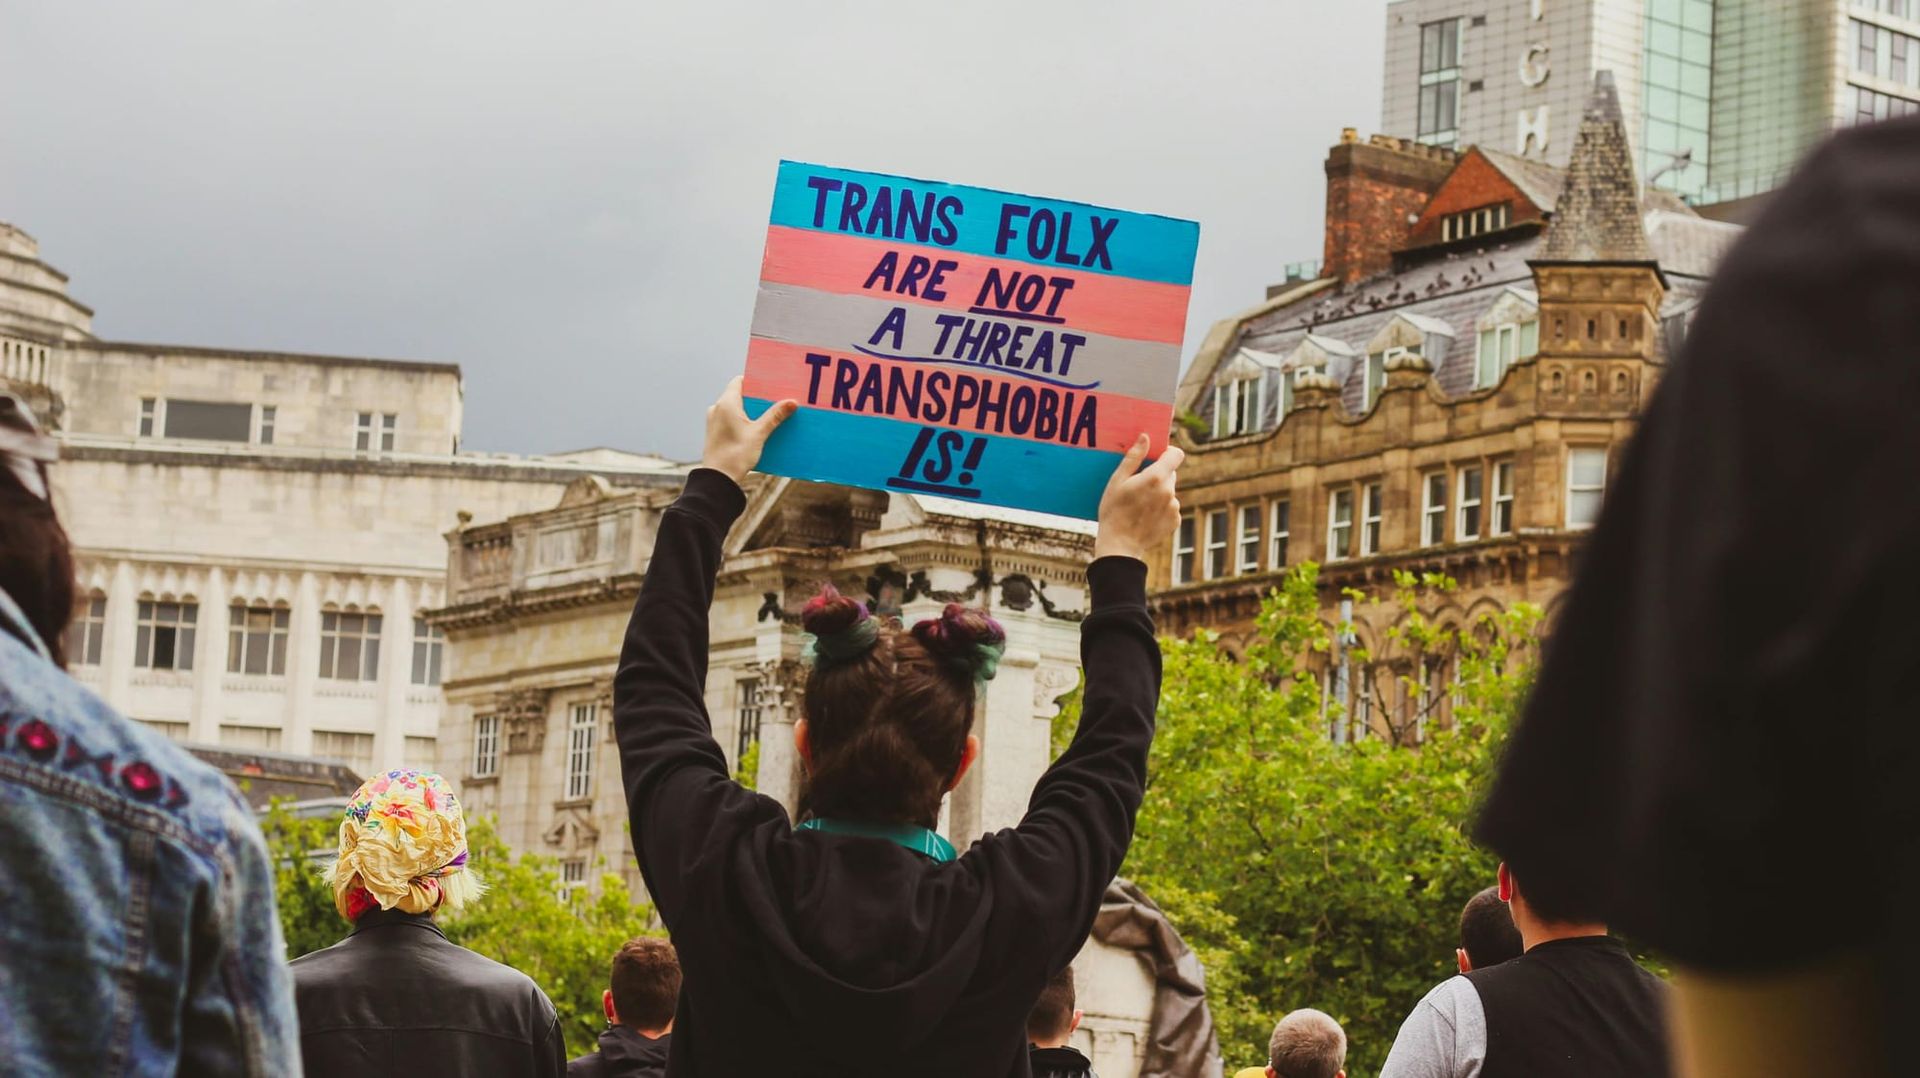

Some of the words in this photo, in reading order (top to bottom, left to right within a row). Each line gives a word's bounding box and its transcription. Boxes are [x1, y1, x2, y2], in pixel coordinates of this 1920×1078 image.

[807, 176, 964, 246] TRANS
[995, 203, 1119, 271] FOLX
[863, 251, 958, 301] ARE
[975, 268, 1074, 316] NOT
[867, 307, 907, 350] A
[933, 314, 1086, 376] THREAT
[805, 353, 1098, 448] TRANSPHOBIA
[899, 428, 988, 485] IS!
